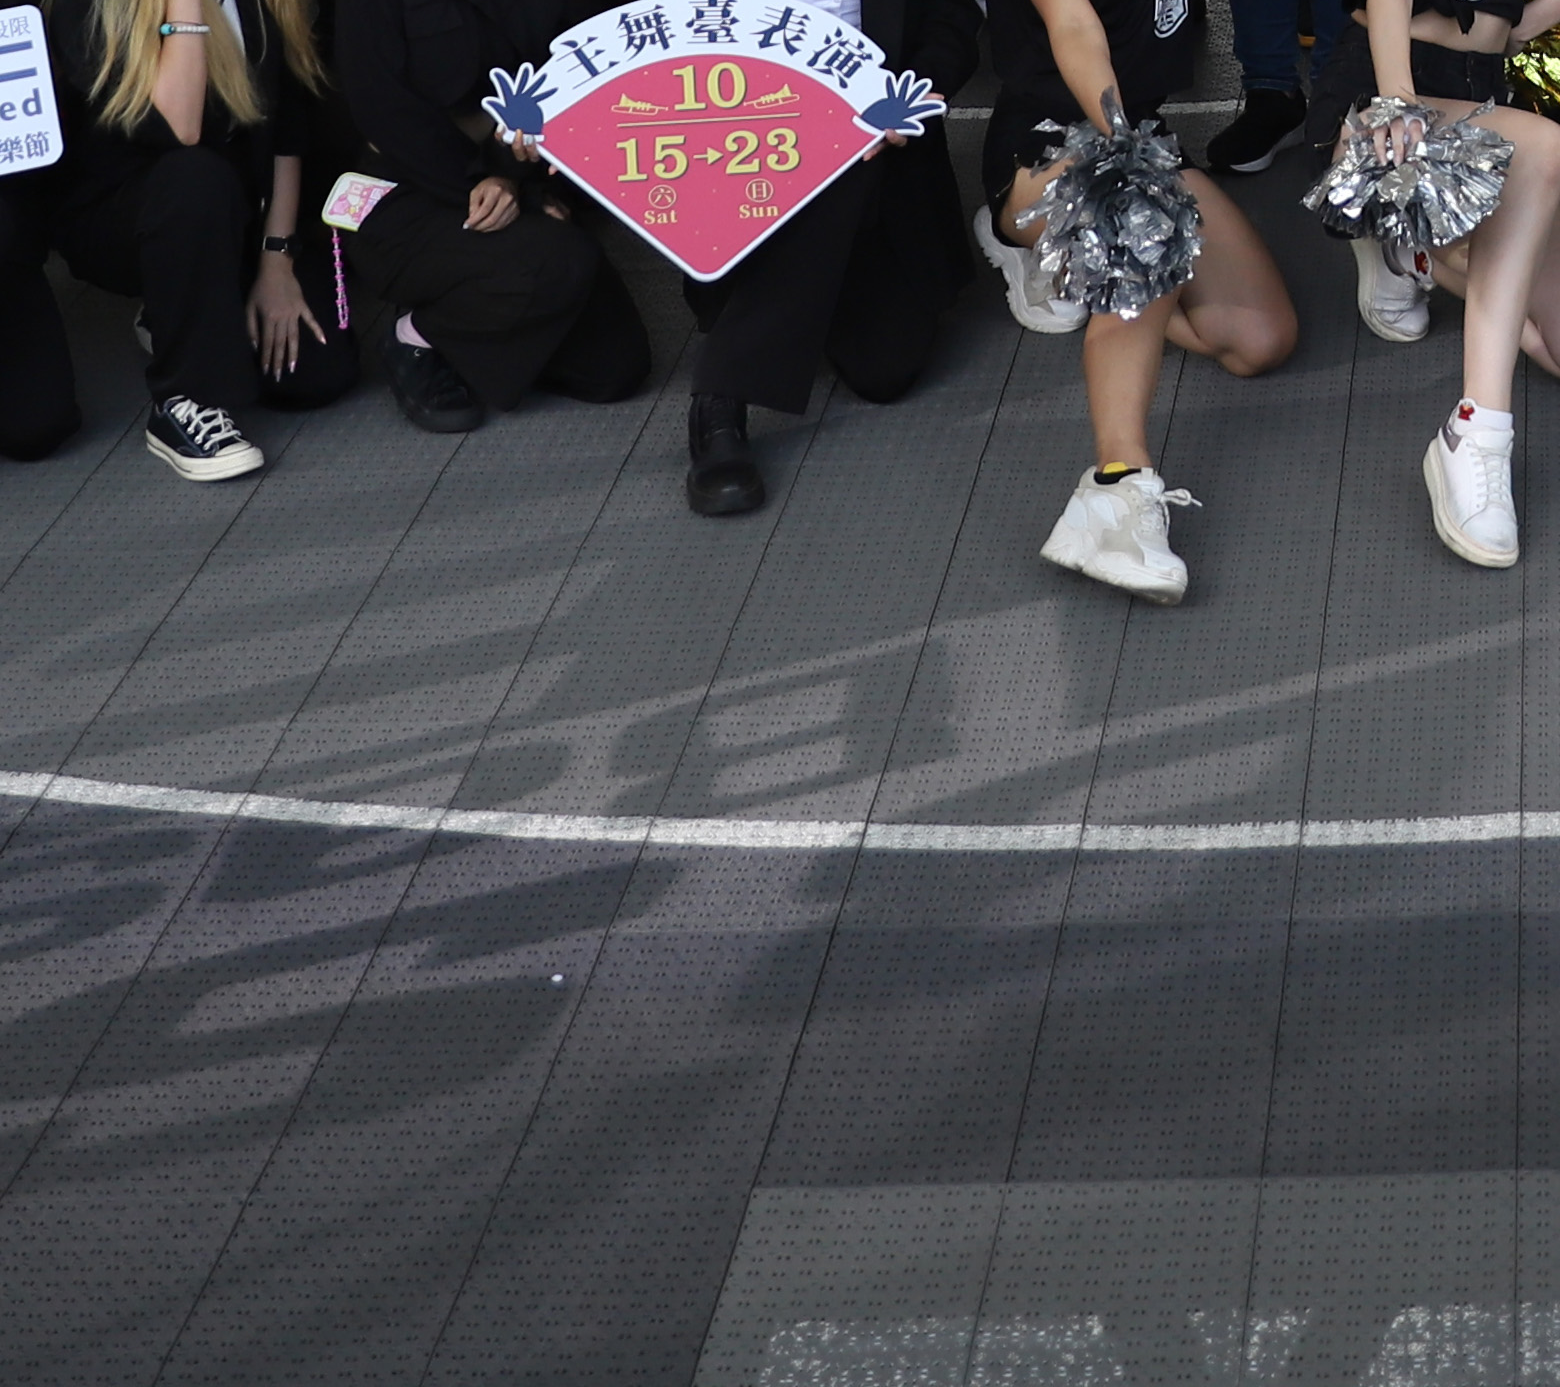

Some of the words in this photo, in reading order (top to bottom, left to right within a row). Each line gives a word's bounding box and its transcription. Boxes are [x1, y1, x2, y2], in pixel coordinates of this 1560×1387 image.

[672, 61, 747, 111] 10
[616, 135, 690, 183] 15
[724, 127, 802, 176] 23
[643, 206, 679, 226] Sat
[739, 202, 780, 220] Sun
